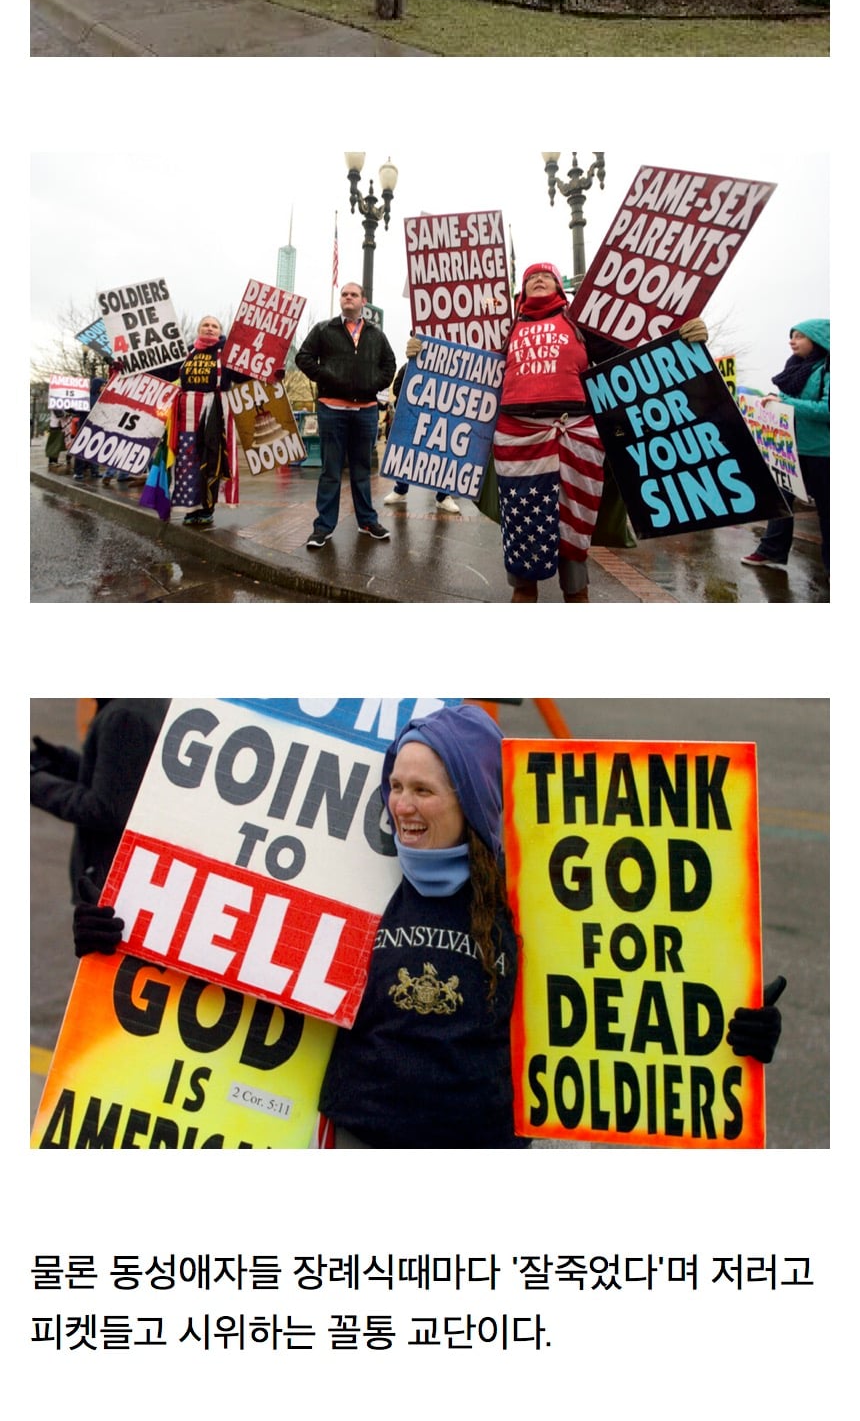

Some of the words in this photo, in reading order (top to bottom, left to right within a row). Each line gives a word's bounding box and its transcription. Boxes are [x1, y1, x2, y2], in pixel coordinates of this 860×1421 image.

[625, 167, 773, 230] SAME-SEX
[407, 212, 503, 252] SAME-SEX
[606, 209, 741, 277] PARENTS
[410, 248, 506, 285] MARRIAGE
[593, 250, 701, 316] DOOM
[98, 280, 170, 315] SOLDIERS
[122, 306, 159, 330] DIE
[236, 301, 299, 340] PENALTY
[244, 280, 307, 319] DEATH
[414, 281, 508, 321] DOOMS
[577, 290, 674, 348] KIDS
[114, 335, 129, 353] 4
[128, 322, 180, 350] FAG
[252, 332, 265, 352] 4
[509, 333, 569, 353] HATES
[514, 345, 560, 363] FAGS
[519, 323, 556, 337] GOD
[118, 339, 188, 375] MARRIAGE
[185, 367, 212, 375] FAGS
[227, 343, 275, 377] FAGS
[416, 341, 506, 389] CHRISTIANS
[586, 338, 713, 415] MOURN
[48, 397, 89, 411] DOOMED
[117, 412, 140, 431] IS
[406, 374, 498, 423] CAUSED
[626, 389, 697, 438] FOR
[69, 426, 151, 474] DOOMED
[246, 433, 305, 475] DOOM
[412, 412, 473, 457] FAG
[626, 421, 729, 477] YOUR
[384, 443, 484, 497] MARRIAGE
[640, 459, 756, 528] SINS
[527, 751, 733, 832] THANK
[234, 821, 306, 881] TO
[548, 835, 713, 913] GOD
[113, 845, 348, 1016] HELL
[372, 925, 506, 977] ENNSYLVANA
[582, 922, 685, 973] FOR
[113, 955, 305, 1072] GOD
[546, 973, 725, 1057] DEAD
[163, 1059, 212, 1113] IS
[232, 1086, 241, 1098] 2
[242, 1090, 264, 1107] Cor.
[267, 1099, 290, 1116] 5:11
[527, 1054, 744, 1141] SOLDIERS
